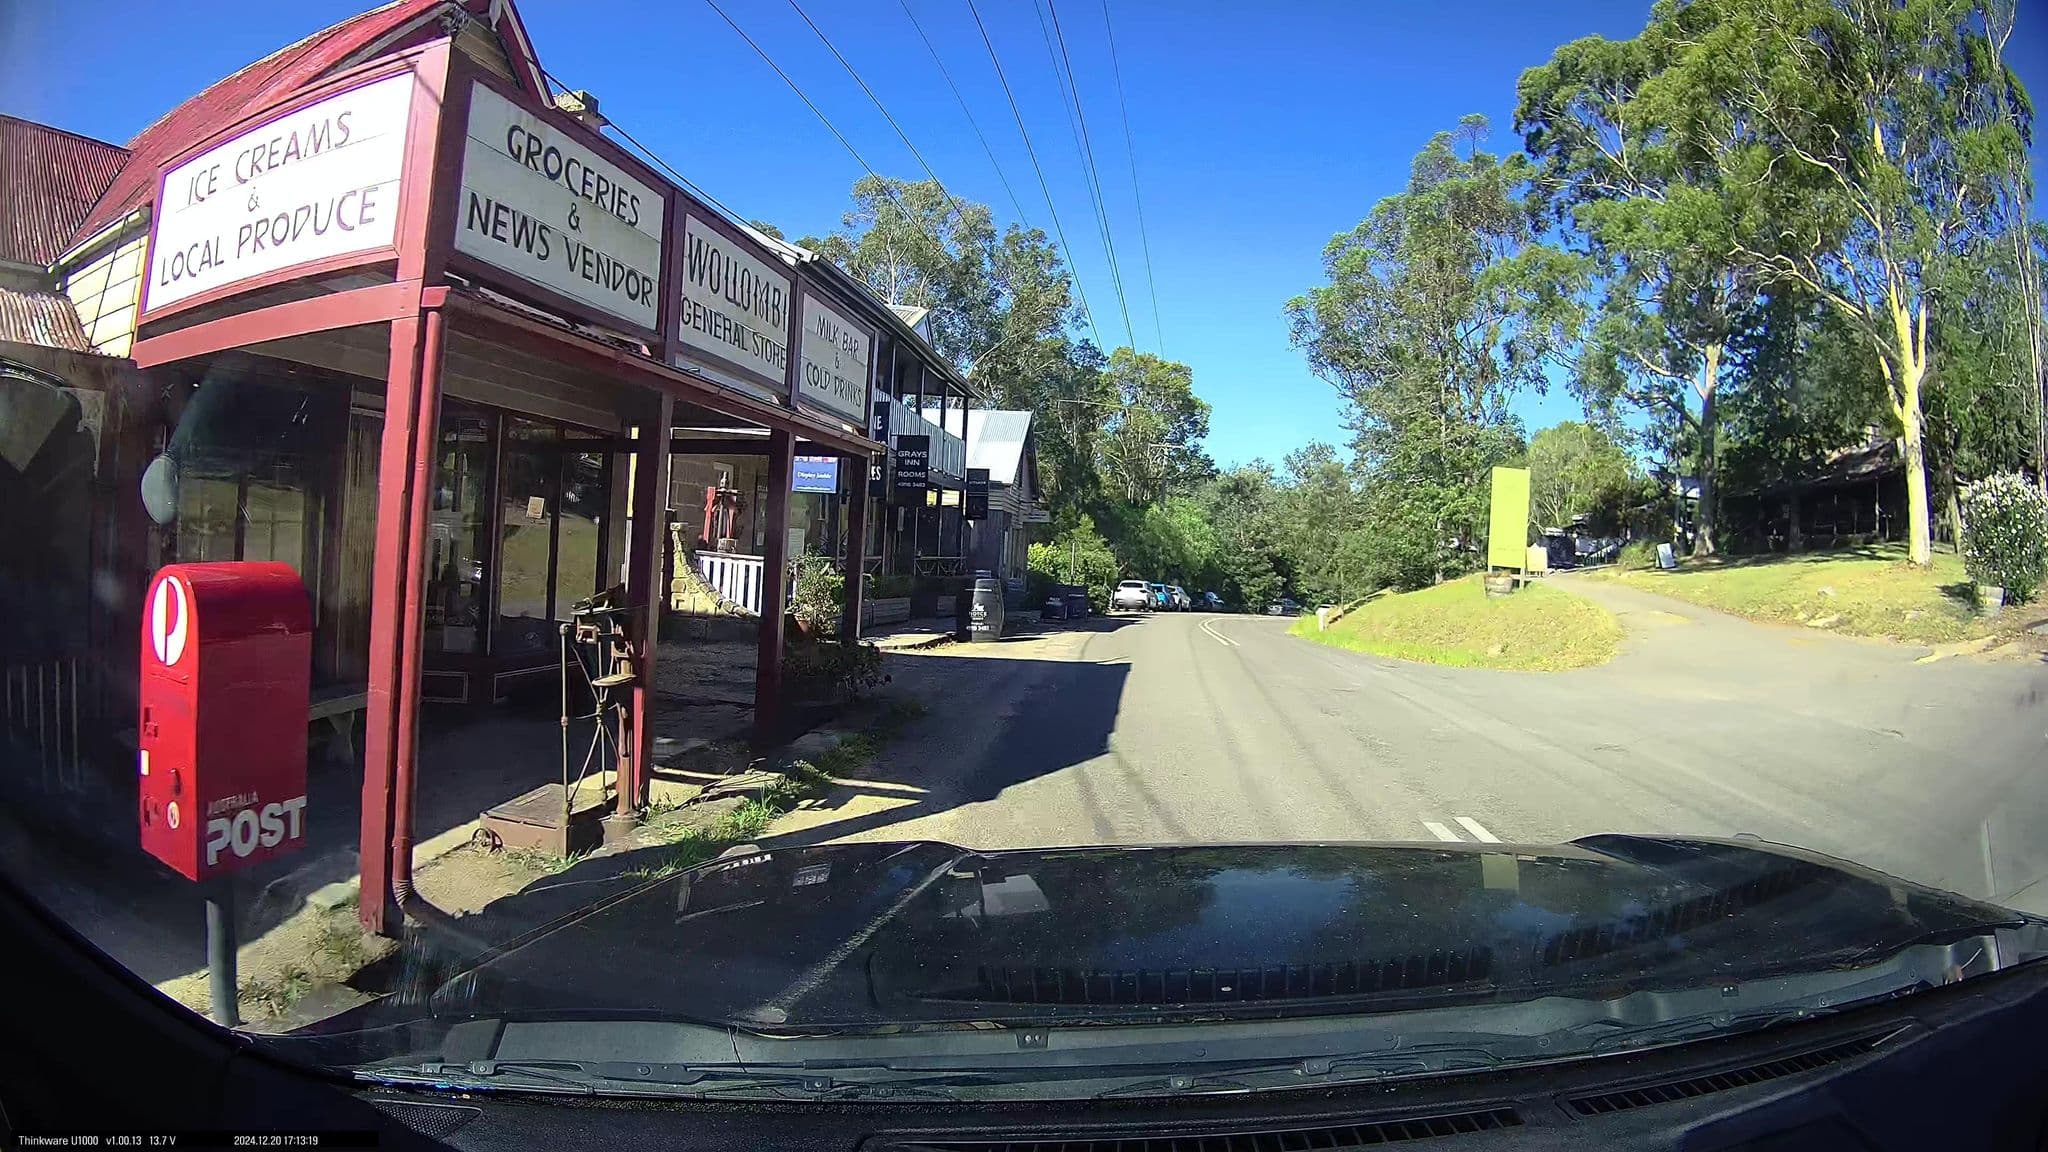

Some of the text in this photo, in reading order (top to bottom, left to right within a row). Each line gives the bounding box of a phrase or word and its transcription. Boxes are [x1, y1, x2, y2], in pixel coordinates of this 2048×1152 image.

[188, 111, 351, 206] ICE CREAMS
[507, 124, 640, 227] GROCERIES
[247, 186, 260, 212] &
[568, 202, 582, 233] &
[161, 187, 378, 286] LOCAL PRODUCE
[467, 192, 653, 307] NEWS VENDOR
[686, 232, 788, 332] WOLLOMBI
[681, 296, 786, 371] GENERAL STORE
[816, 314, 859, 361] MILK BAR
[834, 352, 840, 369] &
[806, 362, 864, 408] COLD DRINKS
[898, 450, 928, 458] GRAYS
[206, 796, 307, 867] POST
